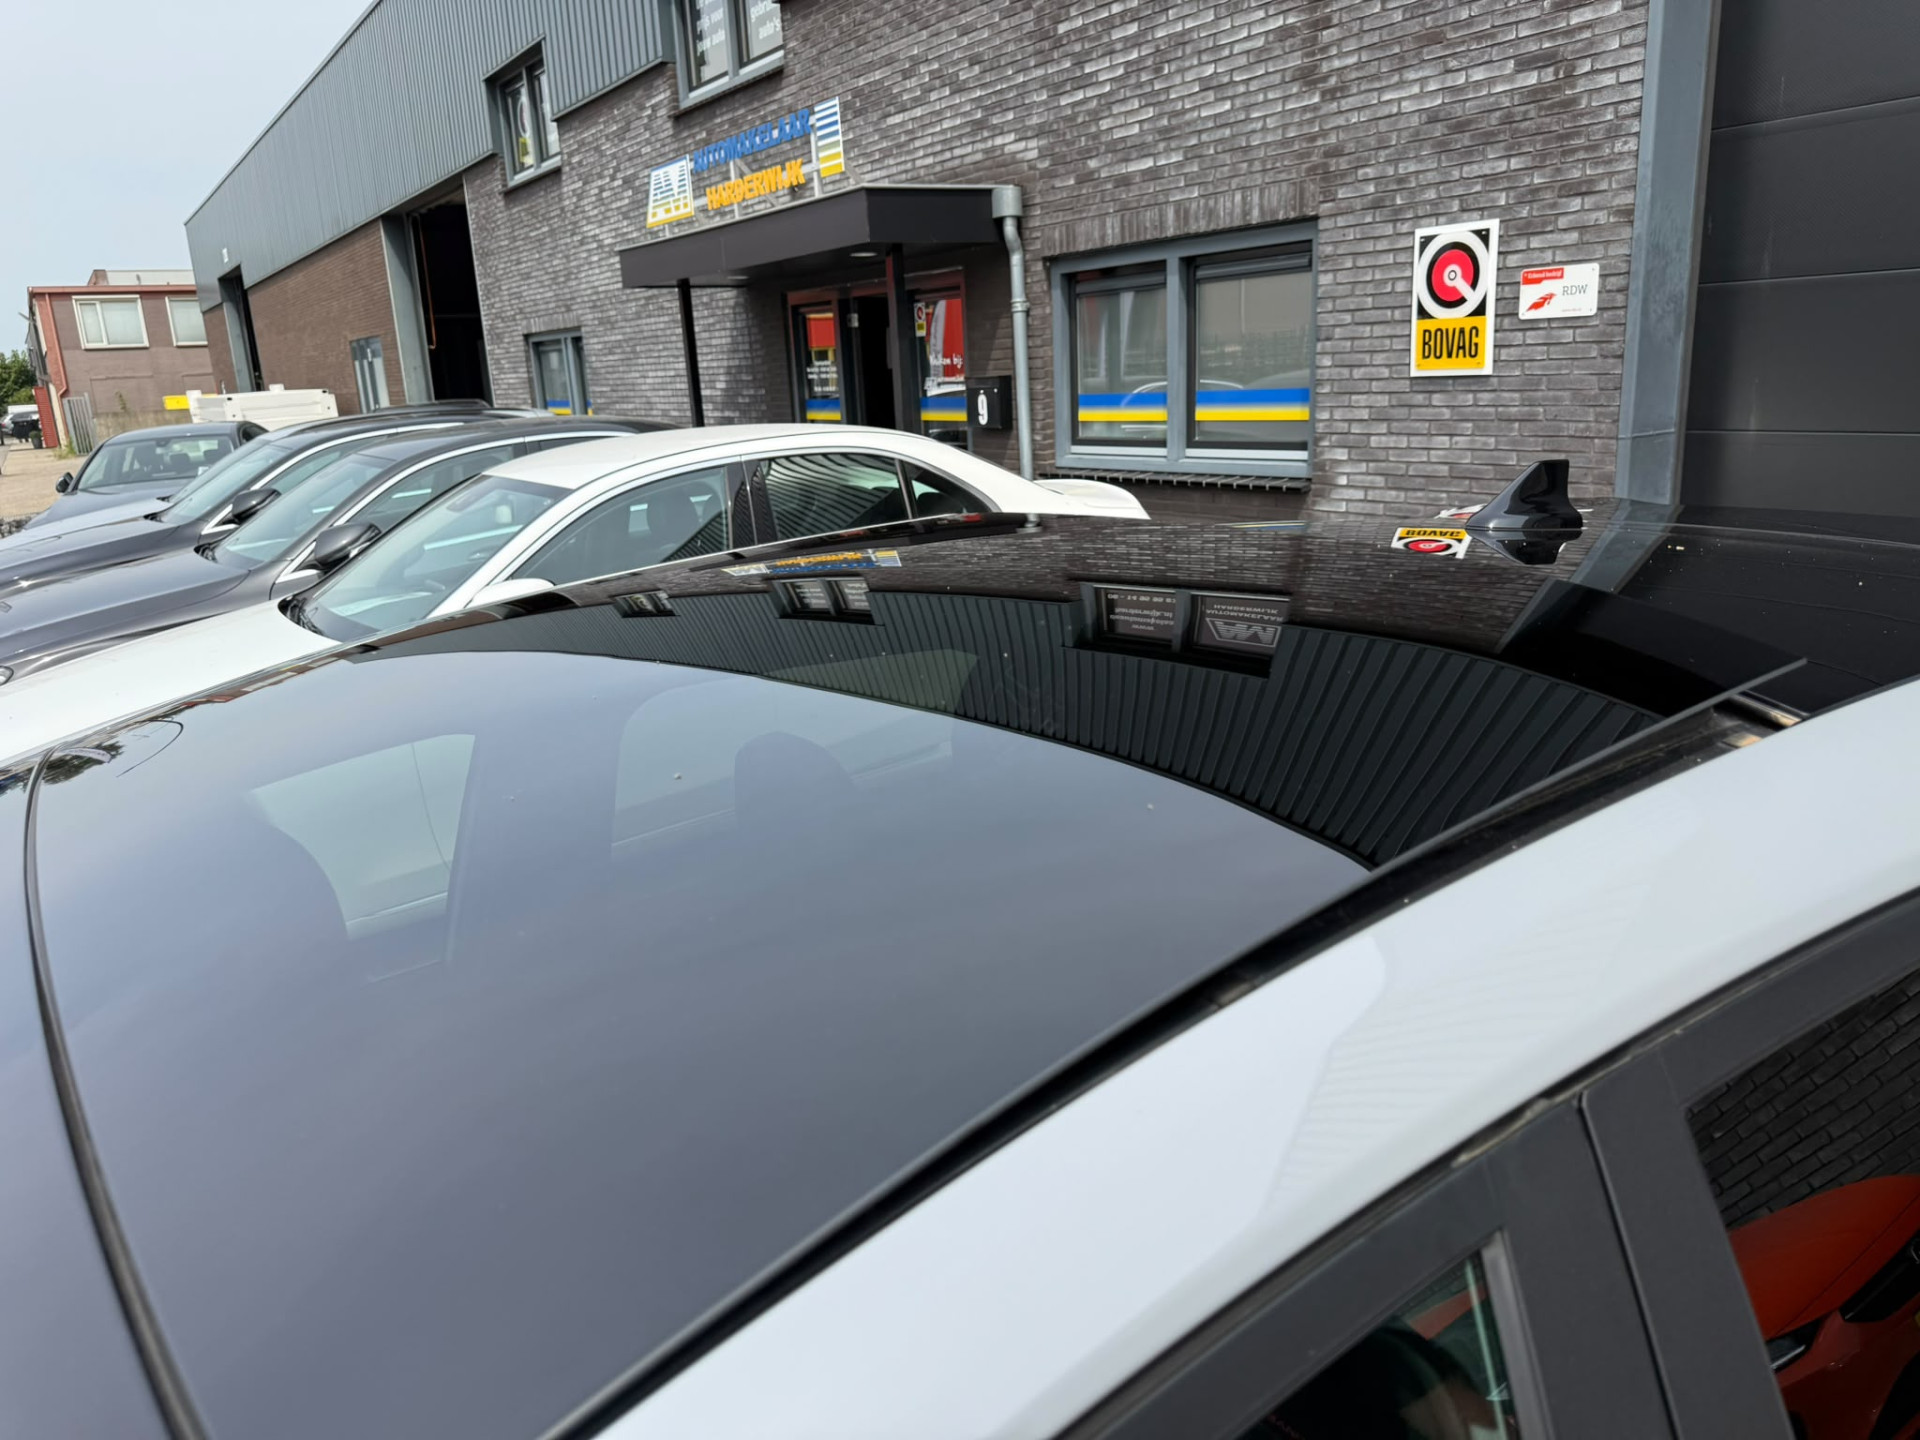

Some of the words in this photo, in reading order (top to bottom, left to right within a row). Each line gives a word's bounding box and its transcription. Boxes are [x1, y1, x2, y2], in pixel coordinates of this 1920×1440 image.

[693, 109, 811, 173] AUTOMAKELAAR
[705, 158, 806, 211] HARDERWIJK
[1562, 284, 1588, 296] RDW
[1422, 326, 1479, 360] BOVAG
[977, 394, 988, 425] 9
